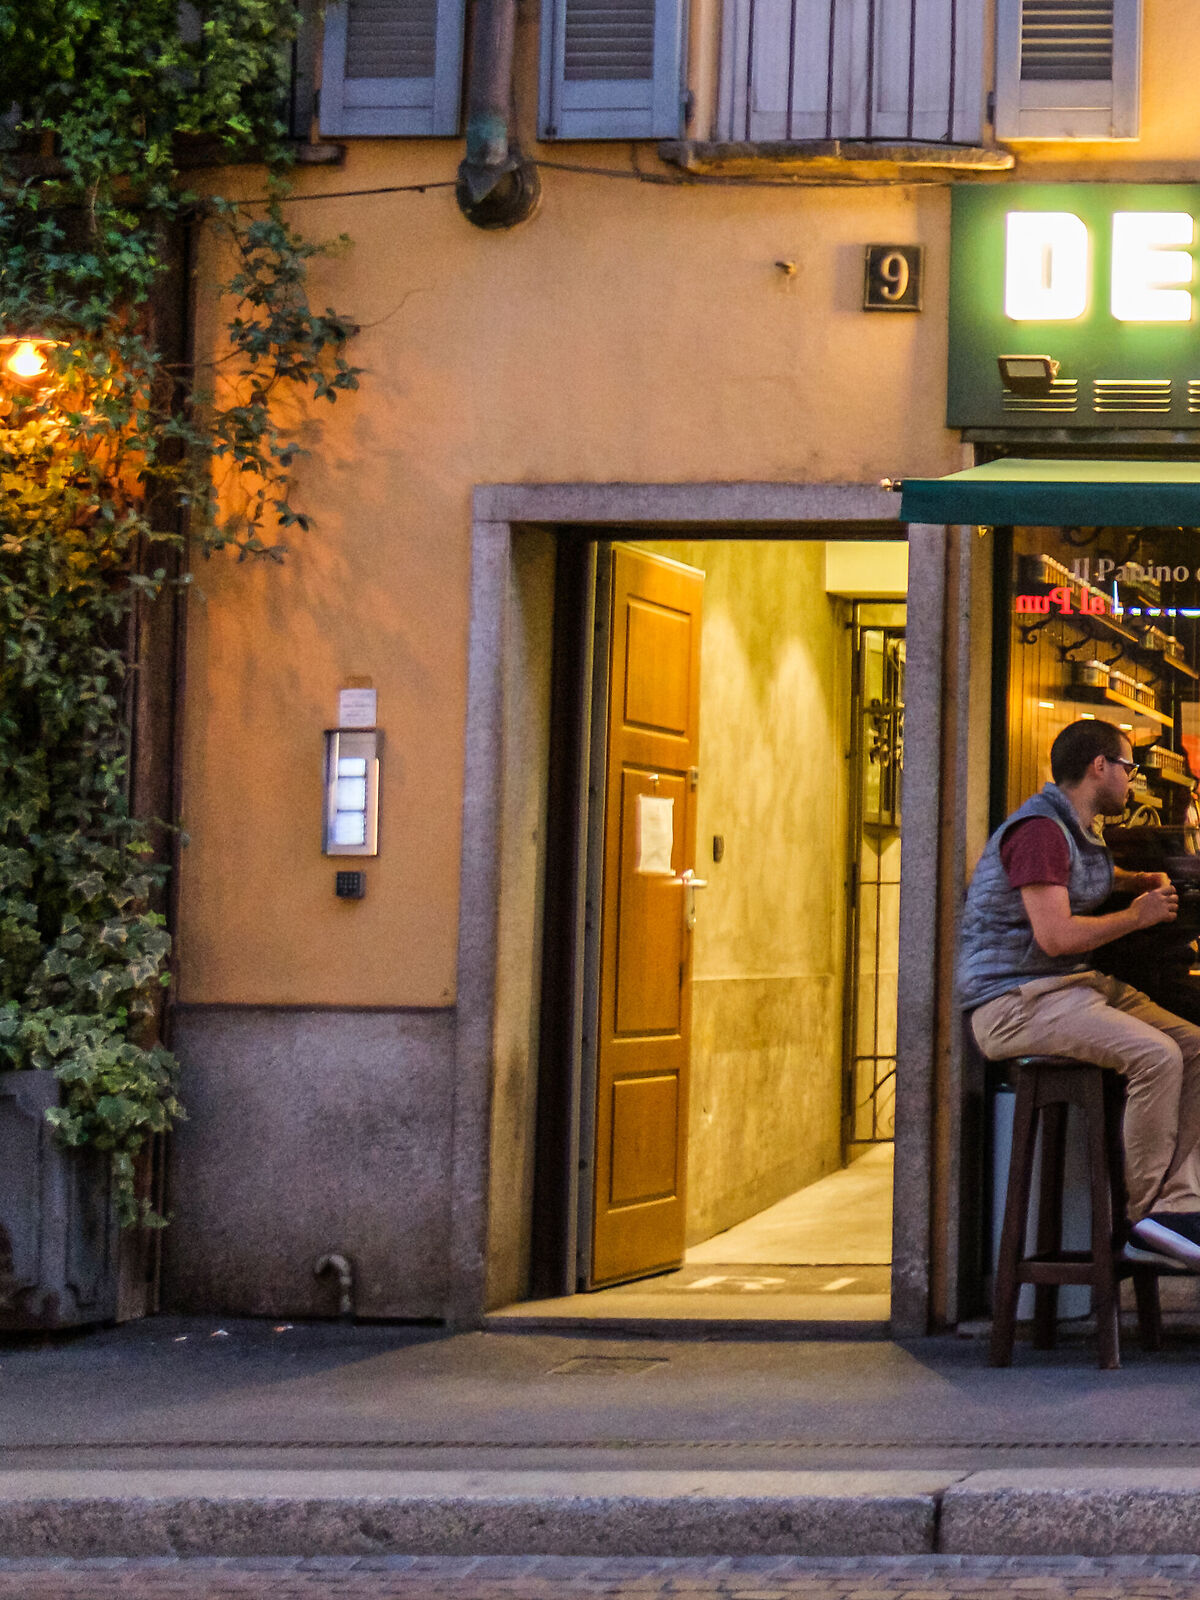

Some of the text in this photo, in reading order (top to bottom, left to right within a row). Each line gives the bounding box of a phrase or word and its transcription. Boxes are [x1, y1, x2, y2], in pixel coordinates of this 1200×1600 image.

[880, 251, 909, 301] 9
[1004, 211, 1196, 322] DE
[1074, 557, 1090, 582] Il
[1097, 557, 1190, 583] Panino
